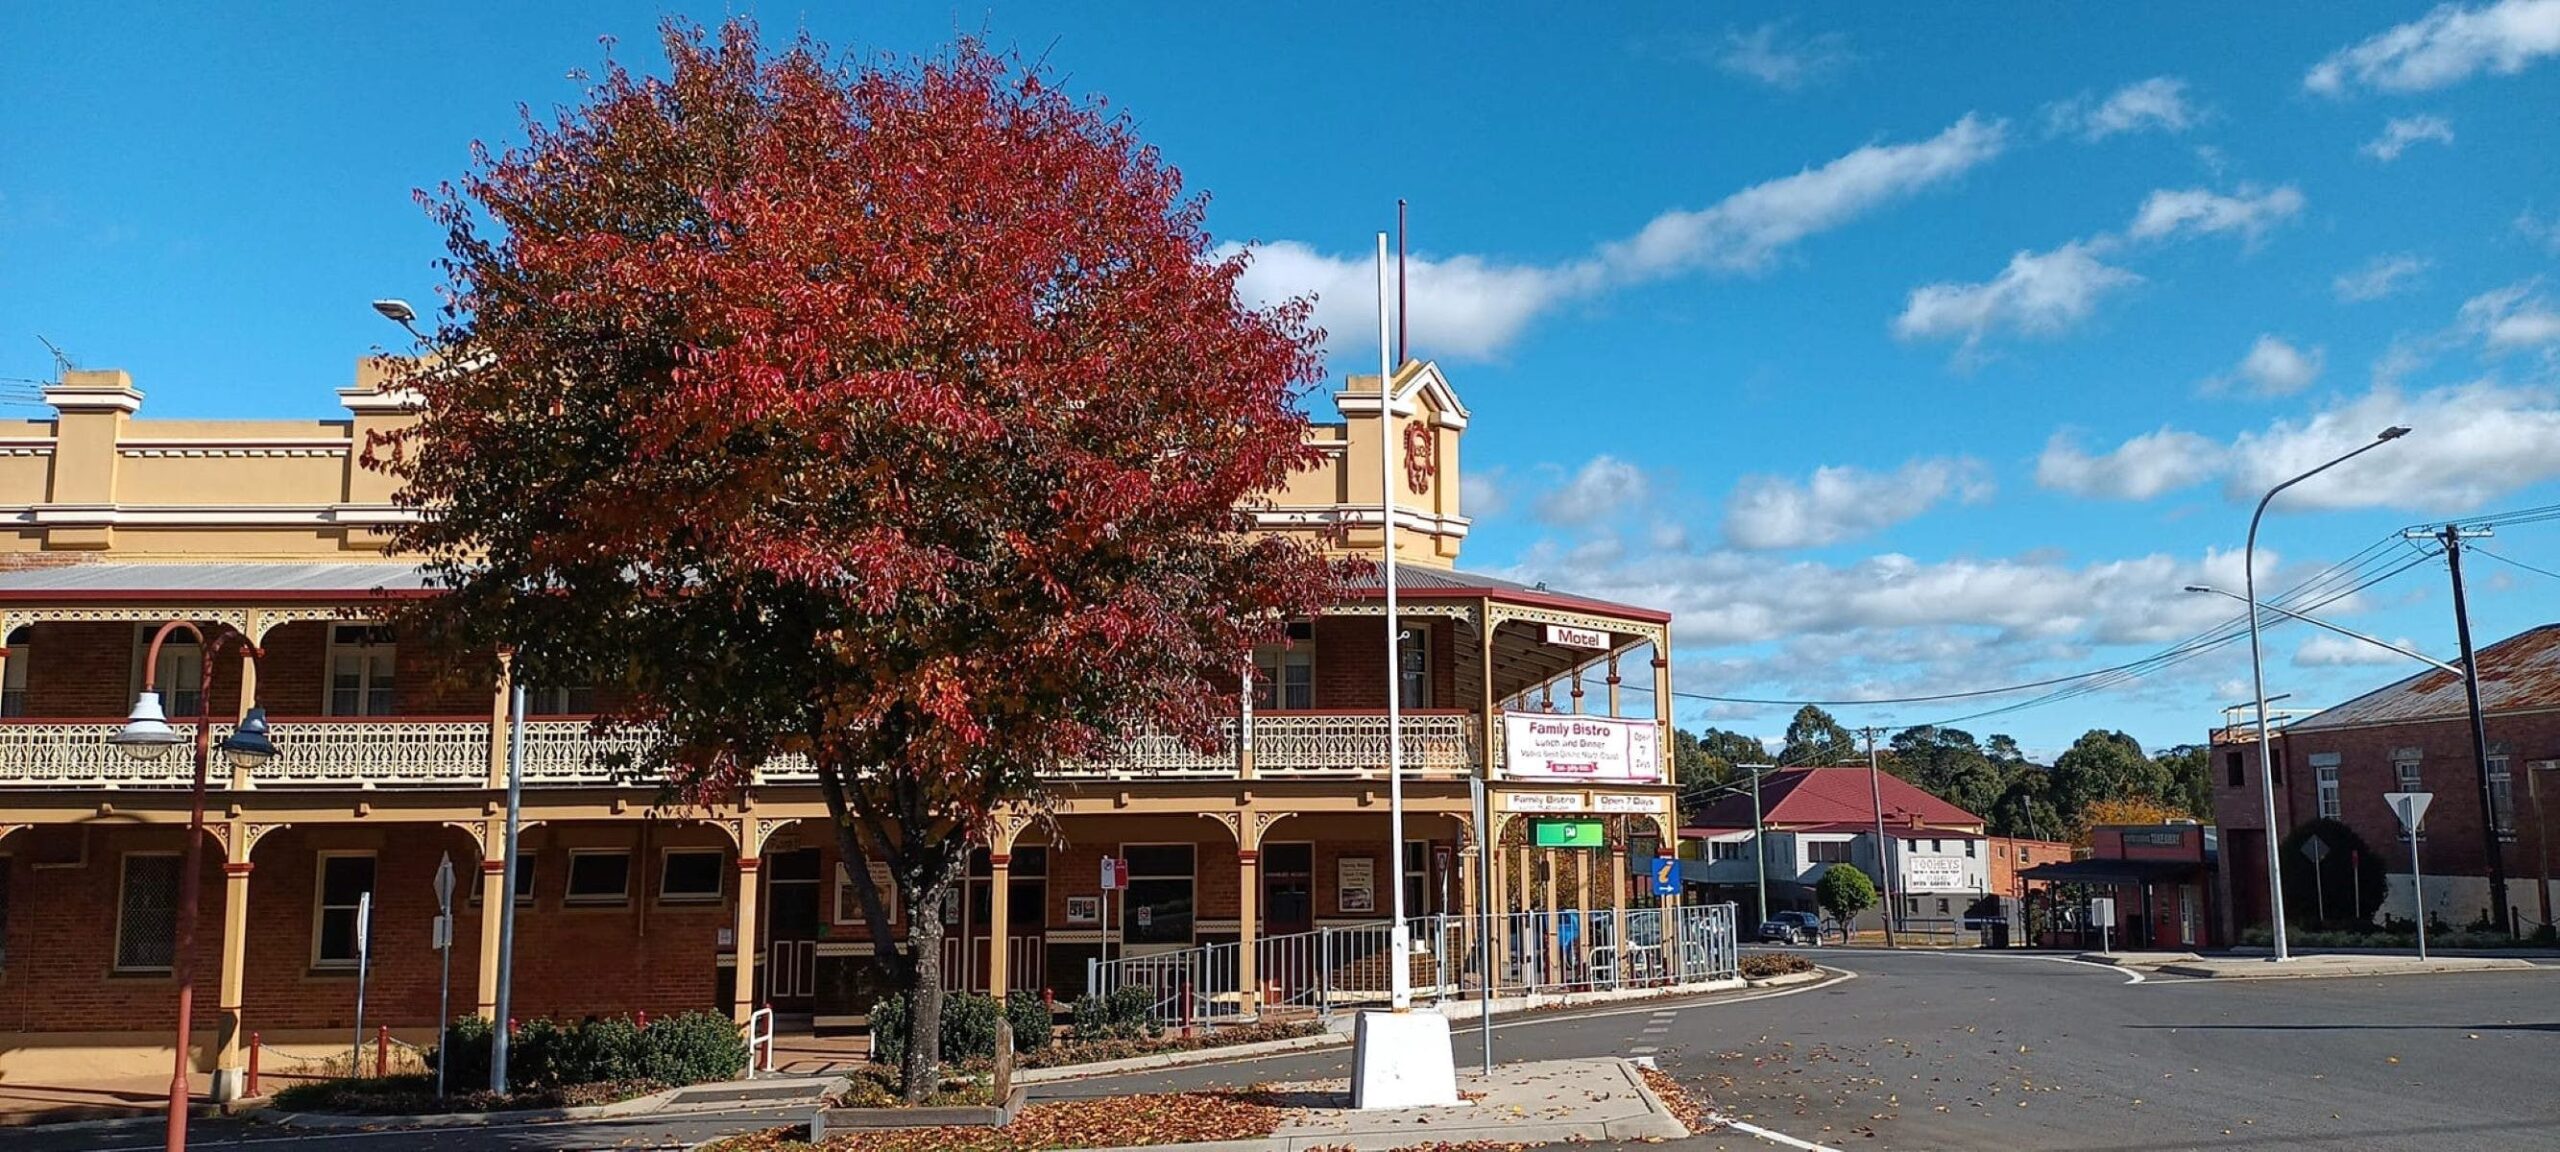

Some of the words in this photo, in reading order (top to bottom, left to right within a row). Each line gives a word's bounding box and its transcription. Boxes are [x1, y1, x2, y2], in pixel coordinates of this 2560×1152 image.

[1558, 629, 1600, 646] Motel
[1529, 722, 1569, 737] Family
[1573, 723, 1611, 737] Bistro
[1535, 739, 1561, 748] Lunch
[1580, 739, 1605, 749] Dinner
[1513, 795, 1544, 805] Family
[1546, 795, 1576, 804] Bistro
[1600, 796, 1625, 805] Open
[1626, 797, 1632, 805] 7
[1633, 797, 1654, 806] Days
[1912, 859, 1960, 869] TOOHEYS
